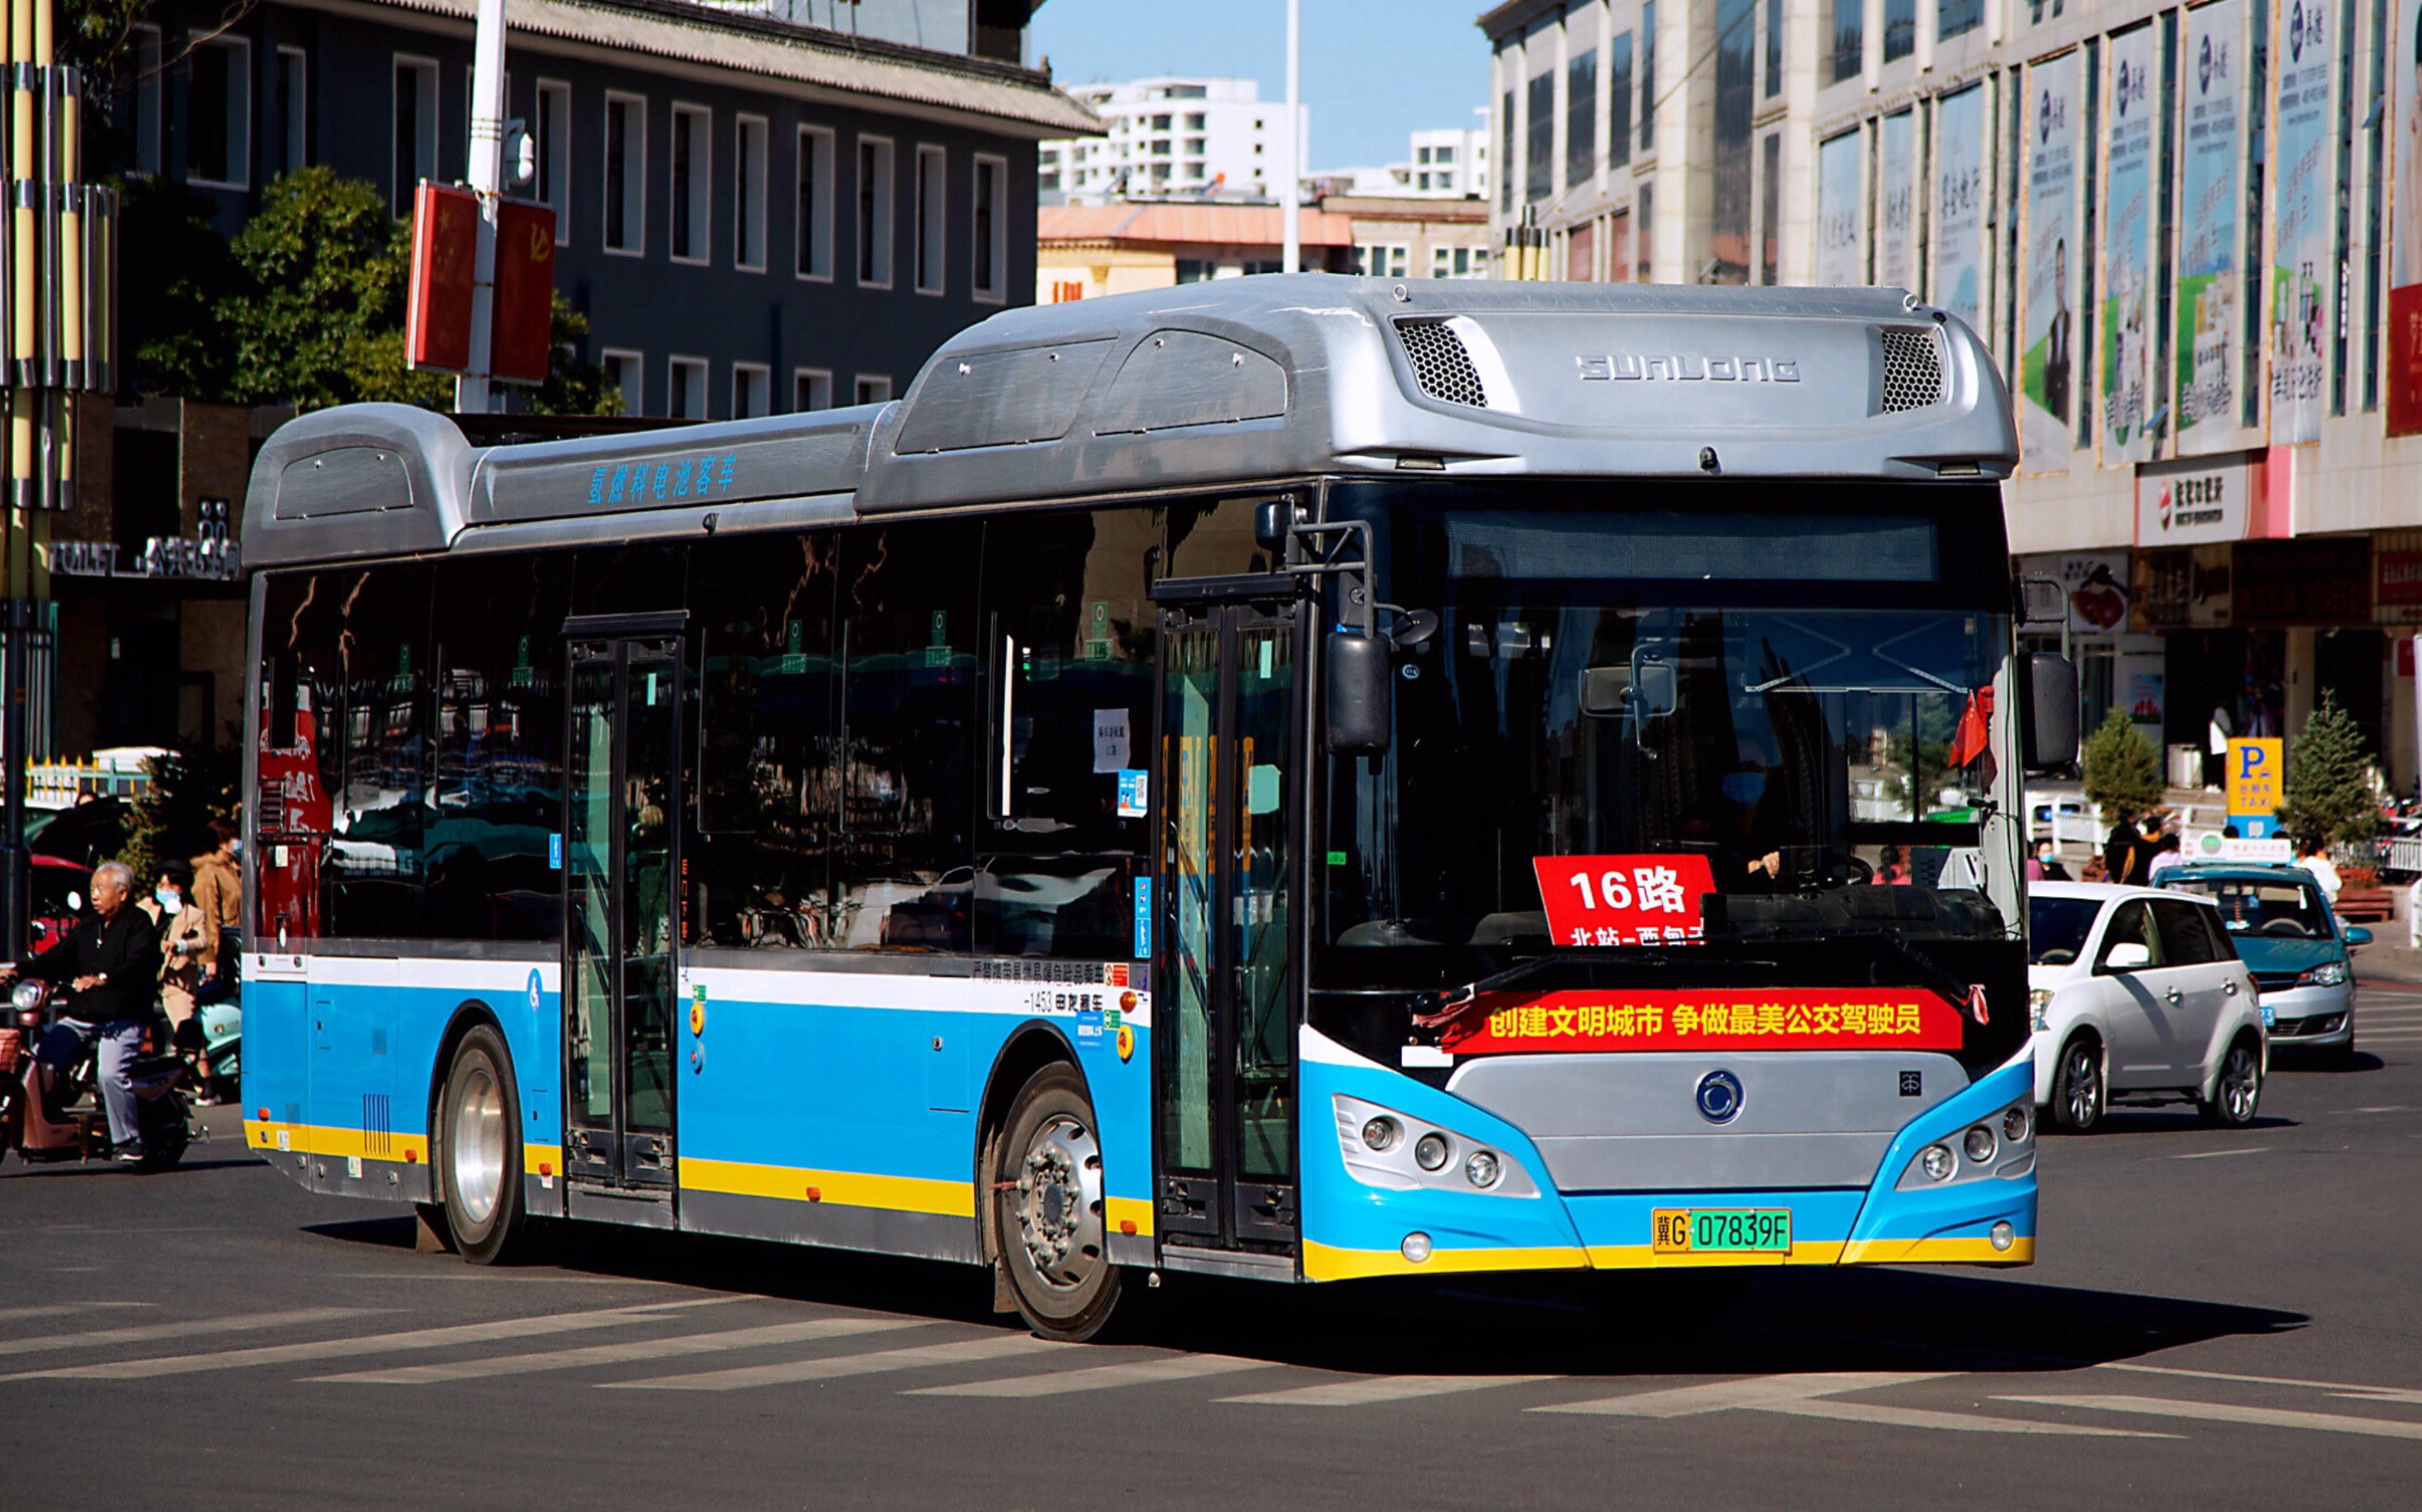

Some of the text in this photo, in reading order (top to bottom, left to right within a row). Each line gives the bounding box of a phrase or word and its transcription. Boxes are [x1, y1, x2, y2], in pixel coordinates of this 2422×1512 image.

[1575, 355, 1800, 383] SUNLONG
[588, 452, 737, 504] 氢燃料电池客车
[49, 541, 120, 575] TOILET
[2239, 745, 2265, 779] P
[2240, 796, 2273, 807] TAXI
[1570, 866, 1686, 913] 16路
[1489, 1002, 1922, 1038] 创建文明城市 争做最美公交驾驶员
[1698, 1214, 1788, 1247] 07839F
